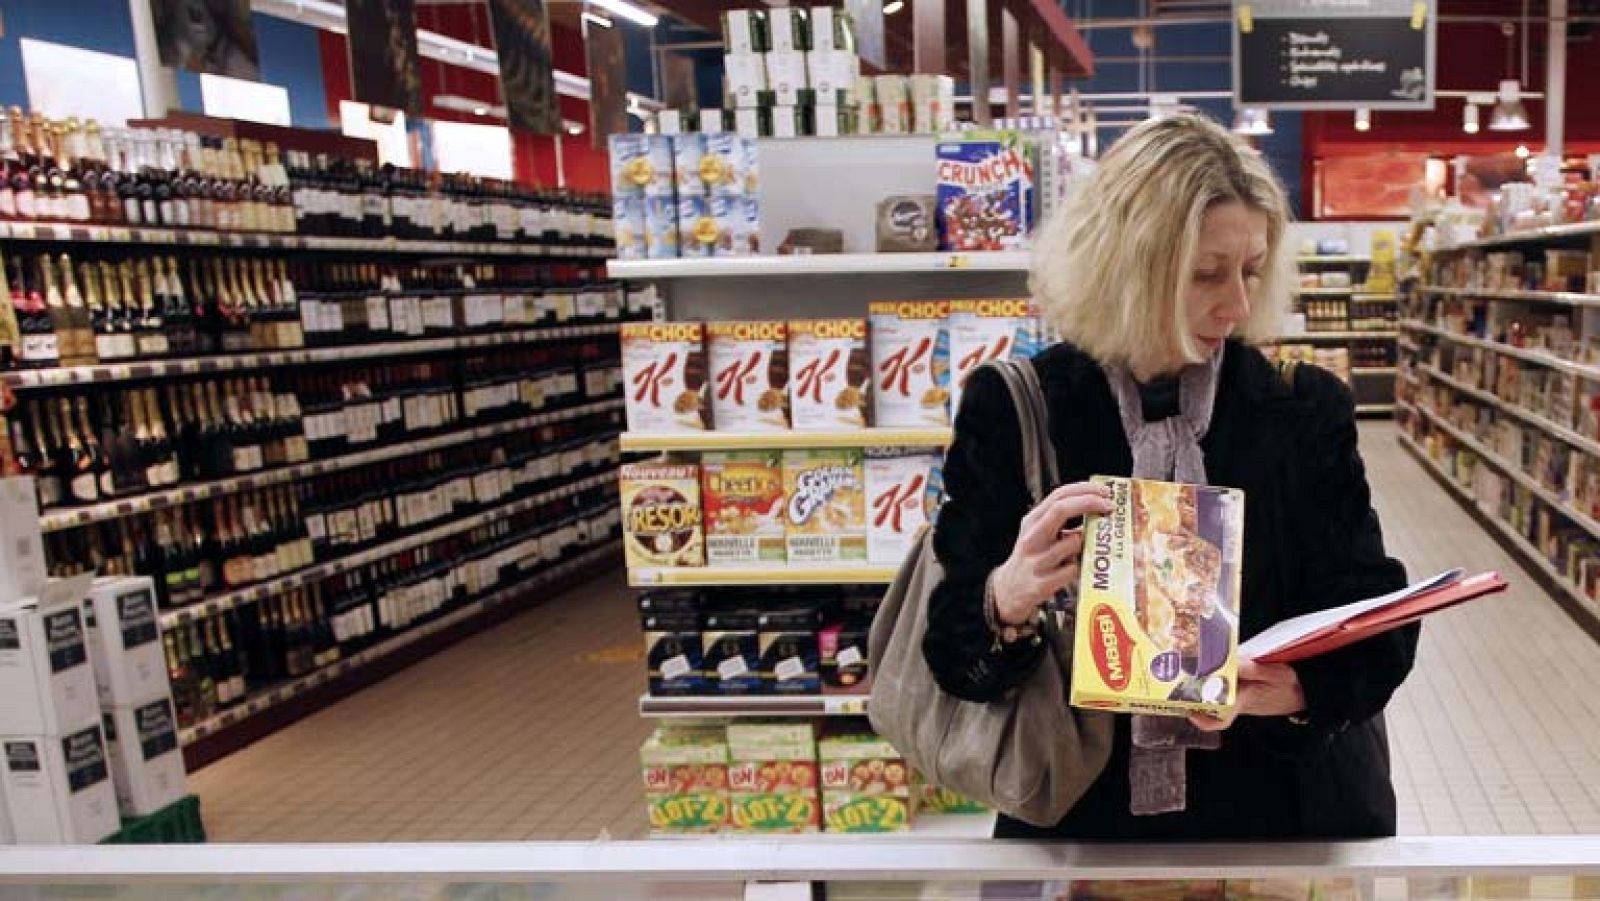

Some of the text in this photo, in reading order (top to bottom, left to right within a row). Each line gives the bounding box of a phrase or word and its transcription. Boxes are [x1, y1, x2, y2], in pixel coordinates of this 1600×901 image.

[939, 149, 1020, 183] CRUNCH
[814, 321, 865, 338] CHOC
[899, 301, 950, 319] CHOC
[977, 300, 1028, 317] CHOC
[650, 324, 701, 341] CHOC
[735, 323, 786, 340] CHOC
[633, 351, 677, 408] K
[717, 350, 762, 406] K
[796, 349, 840, 404] K
[879, 337, 931, 397] K
[873, 474, 924, 533] K
[1095, 613, 1124, 681] Maggi
